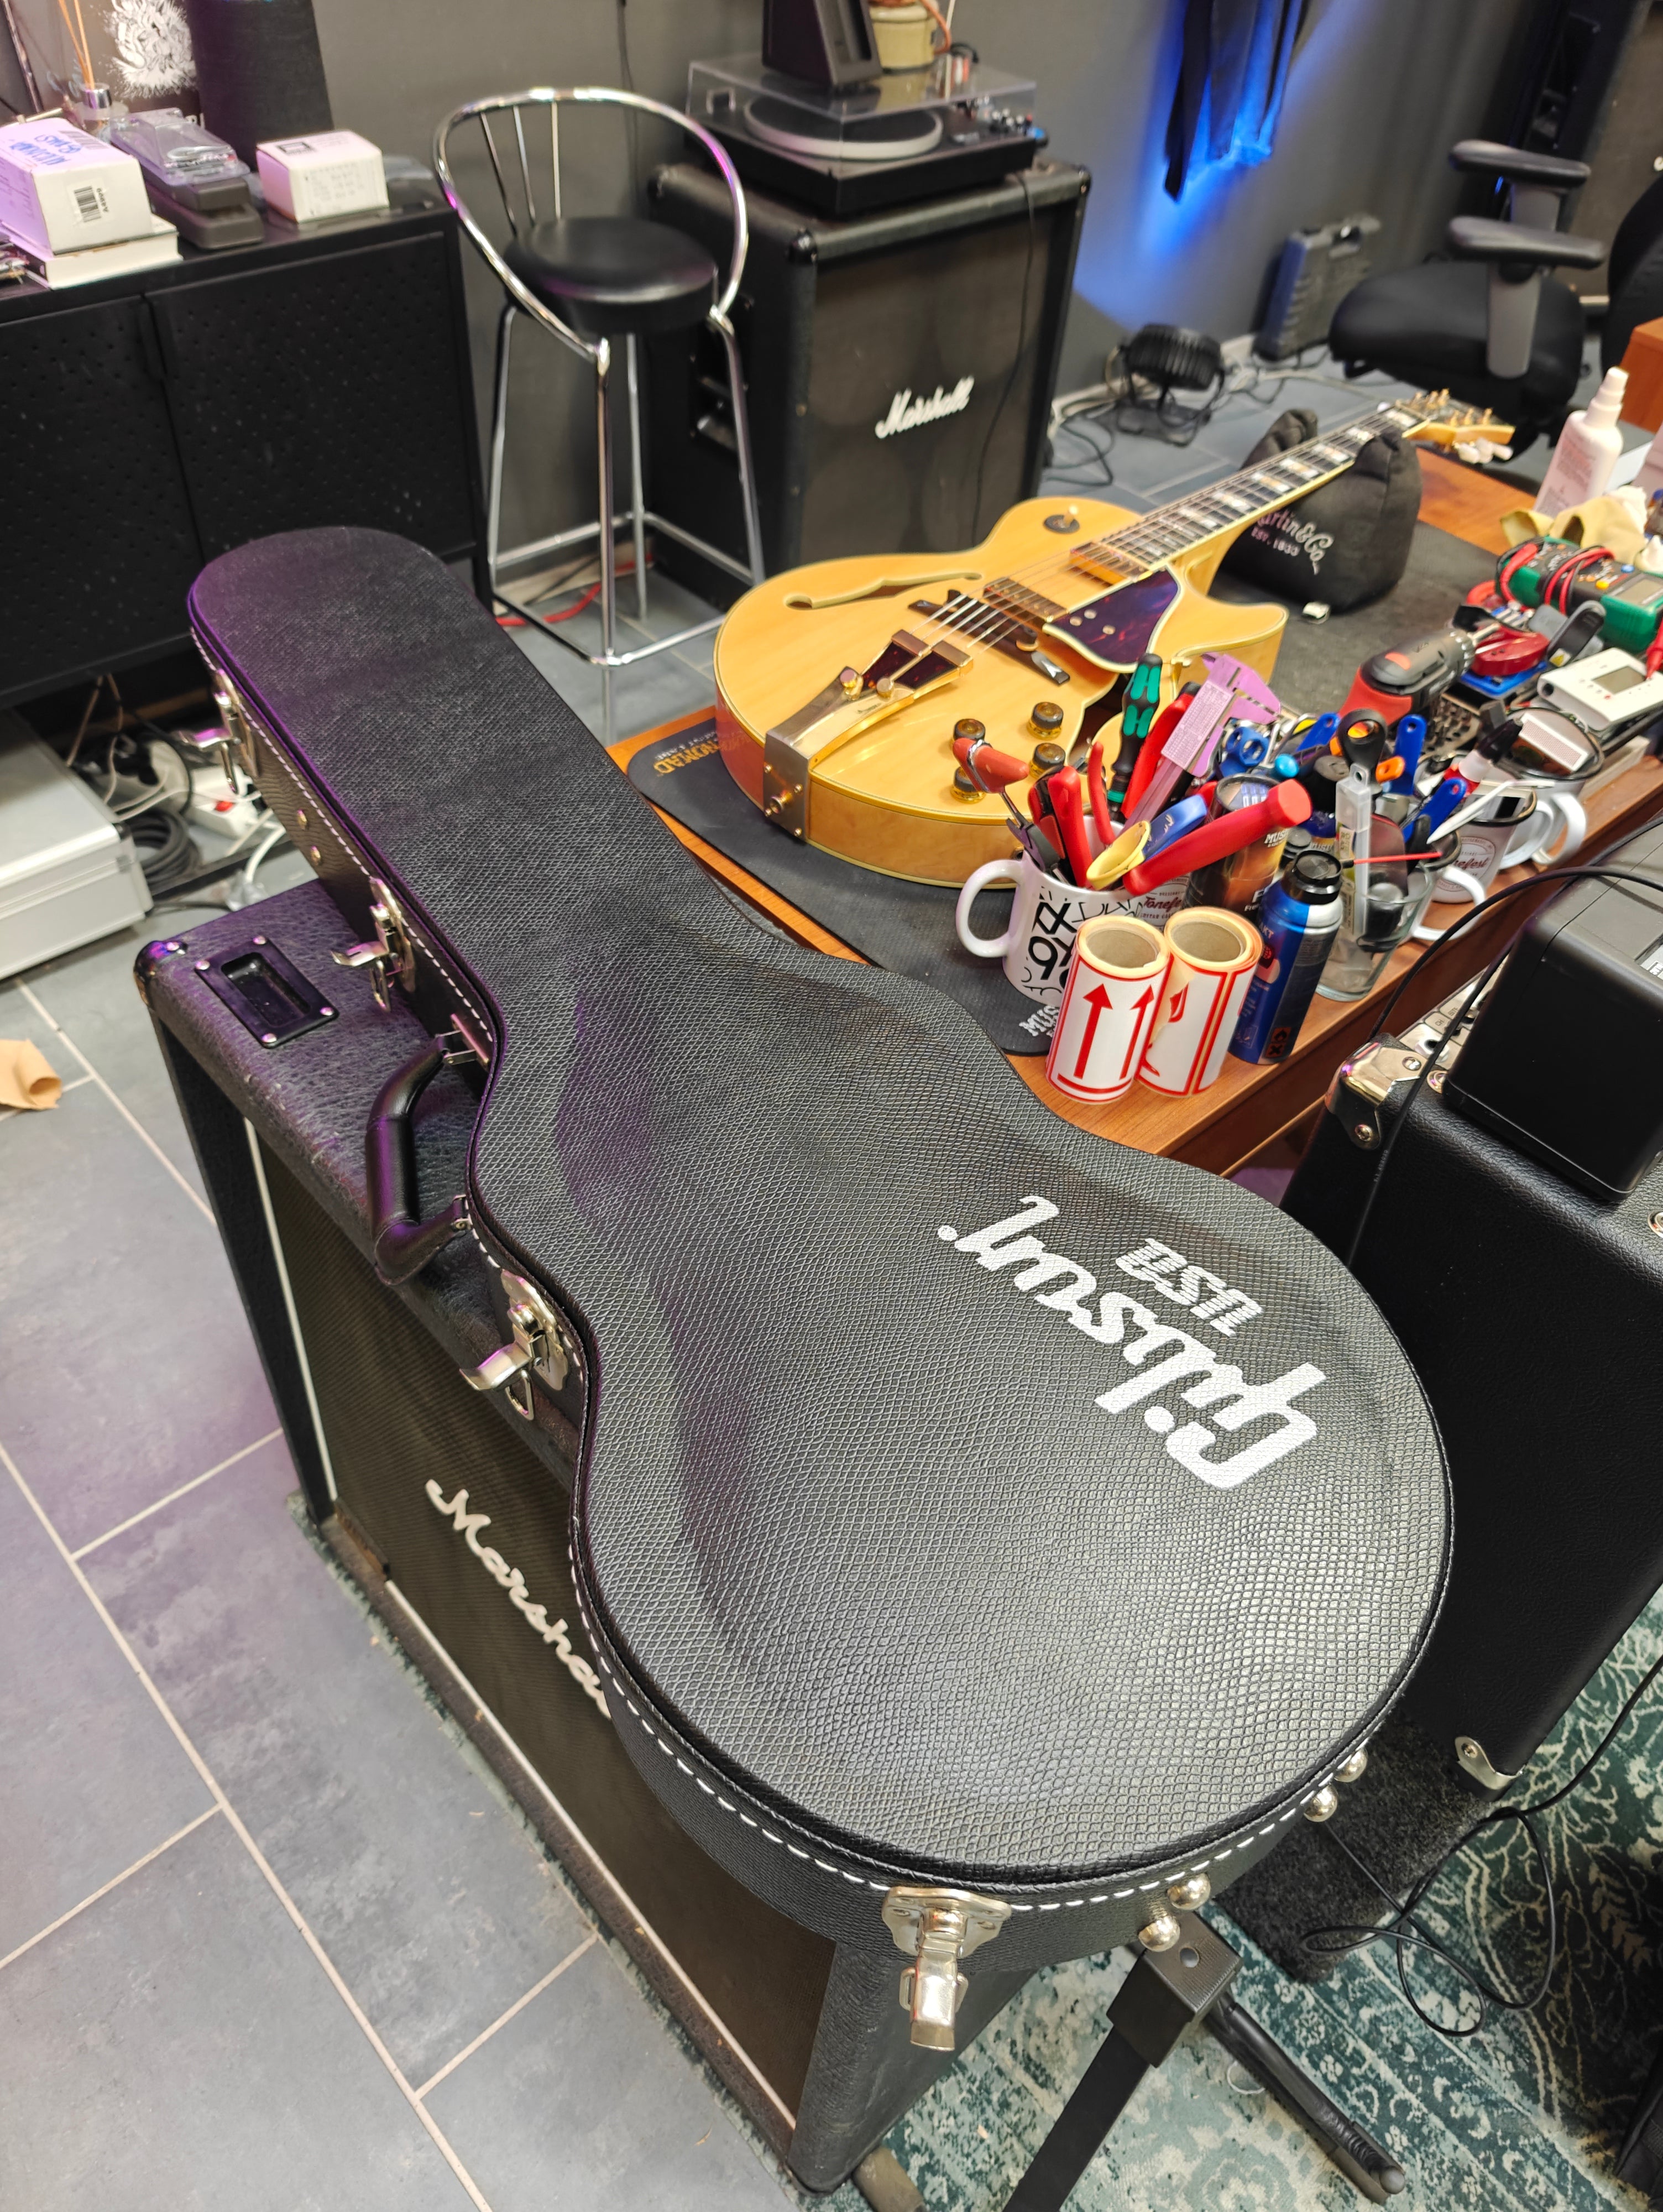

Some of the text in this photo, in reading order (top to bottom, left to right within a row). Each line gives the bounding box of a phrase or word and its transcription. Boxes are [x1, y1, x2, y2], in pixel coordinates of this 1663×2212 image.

[875, 375, 975, 436] Marshall
[1018, 1005, 1060, 1036] MUS
[1116, 1215, 1263, 1337] USA
[938, 1195, 1327, 1488] Gibson
